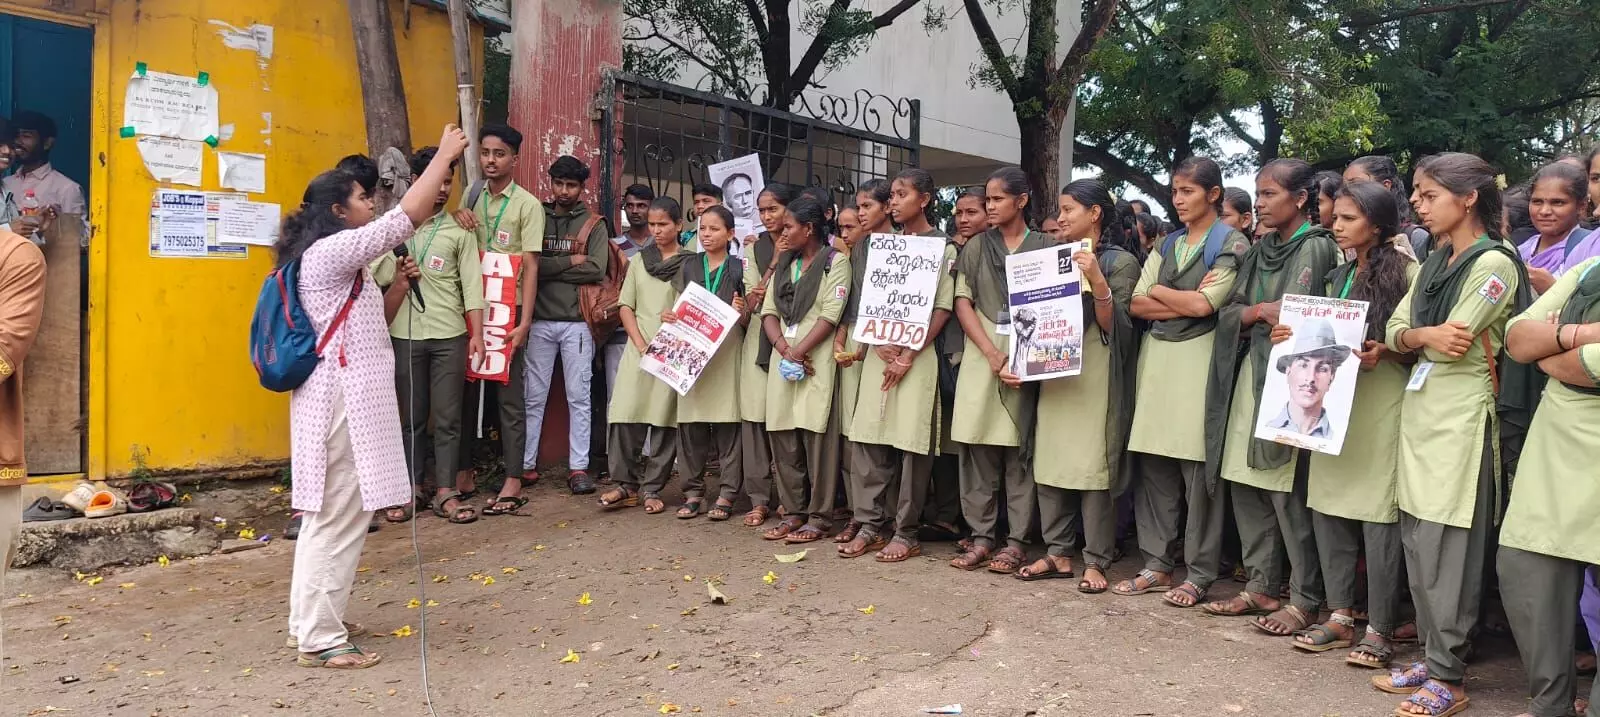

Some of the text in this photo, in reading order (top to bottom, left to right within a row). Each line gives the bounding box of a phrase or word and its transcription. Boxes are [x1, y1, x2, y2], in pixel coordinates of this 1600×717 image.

[163, 236, 204, 247] 7975025375
[1059, 256, 1071, 268] 27
[470, 252, 514, 375] AIDSO
[861, 319, 925, 345] AIDSO
